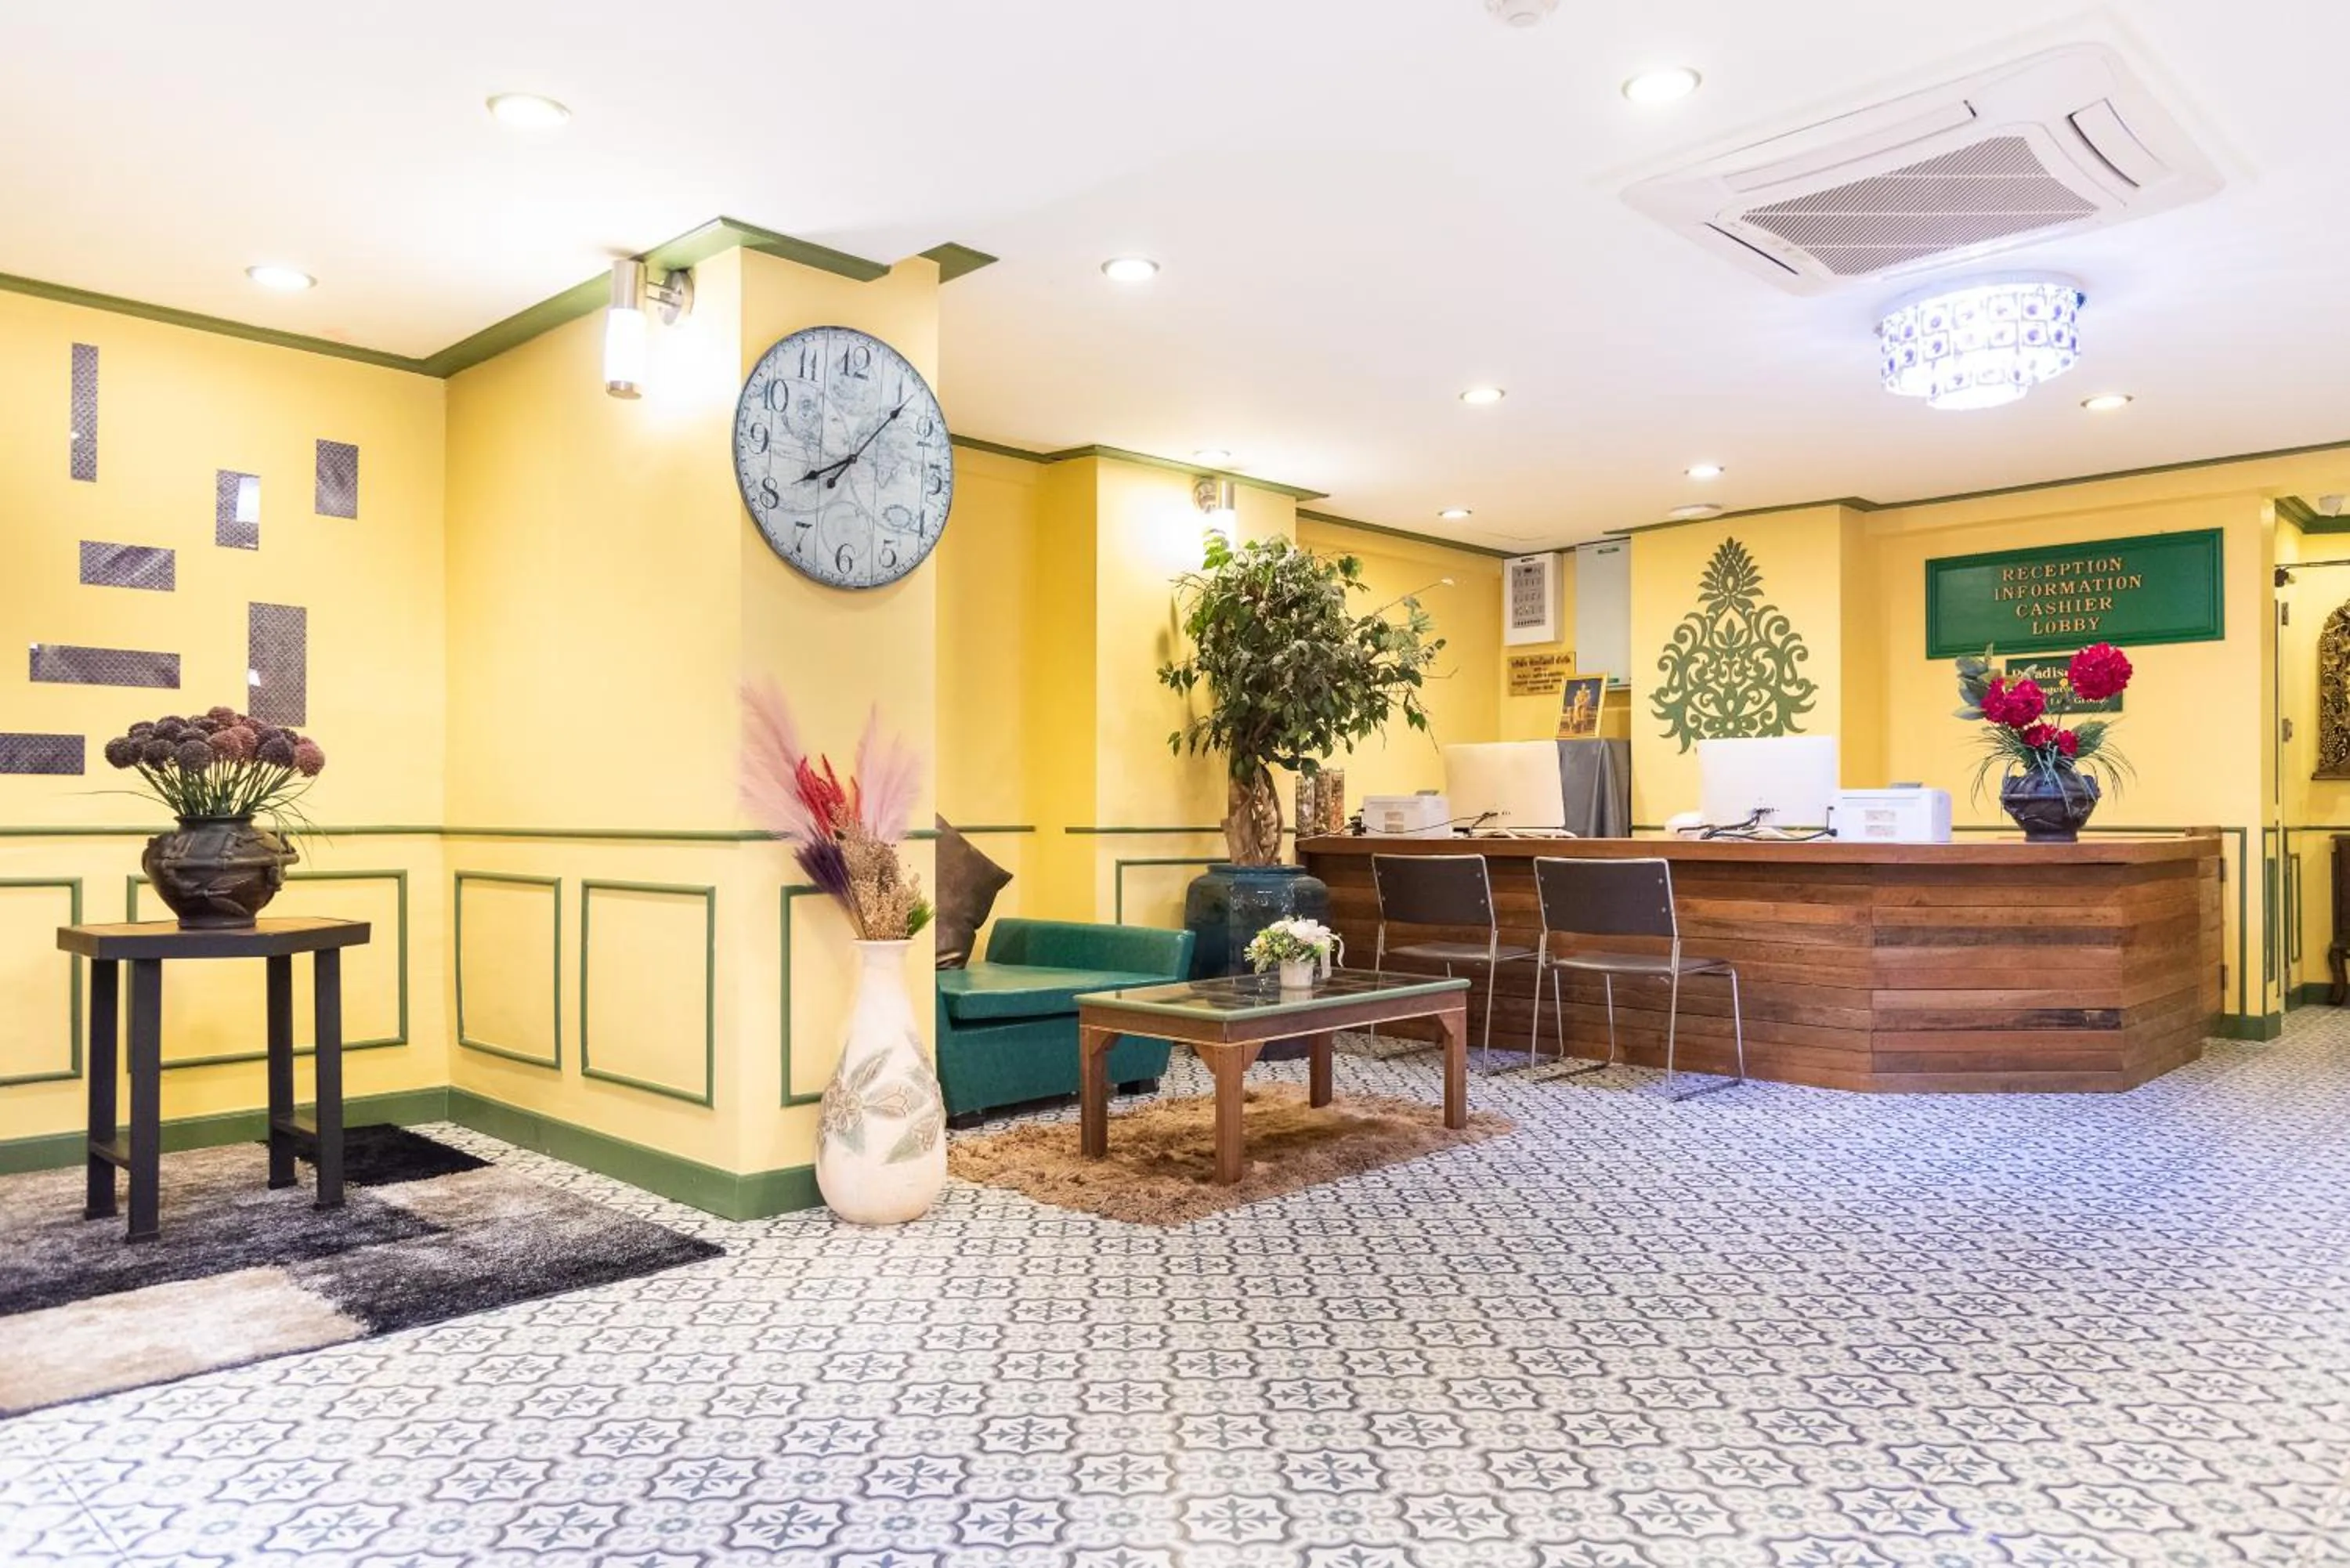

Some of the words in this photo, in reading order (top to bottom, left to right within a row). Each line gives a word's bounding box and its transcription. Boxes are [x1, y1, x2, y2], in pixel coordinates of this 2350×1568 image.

[798, 345, 818, 382] 11
[840, 344, 871, 381] 12
[762, 378, 790, 413] 10
[750, 422, 769, 455] 9
[759, 476, 779, 510] 8
[794, 521, 813, 553] 7
[835, 543, 856, 576] 6
[878, 538, 897, 569] 5
[2002, 557, 2123, 582] RECEPTION
[1994, 574, 2142, 601] INFORMATION
[2016, 597, 2113, 617] CASHIER
[2032, 616, 2101, 635] LOBBY
